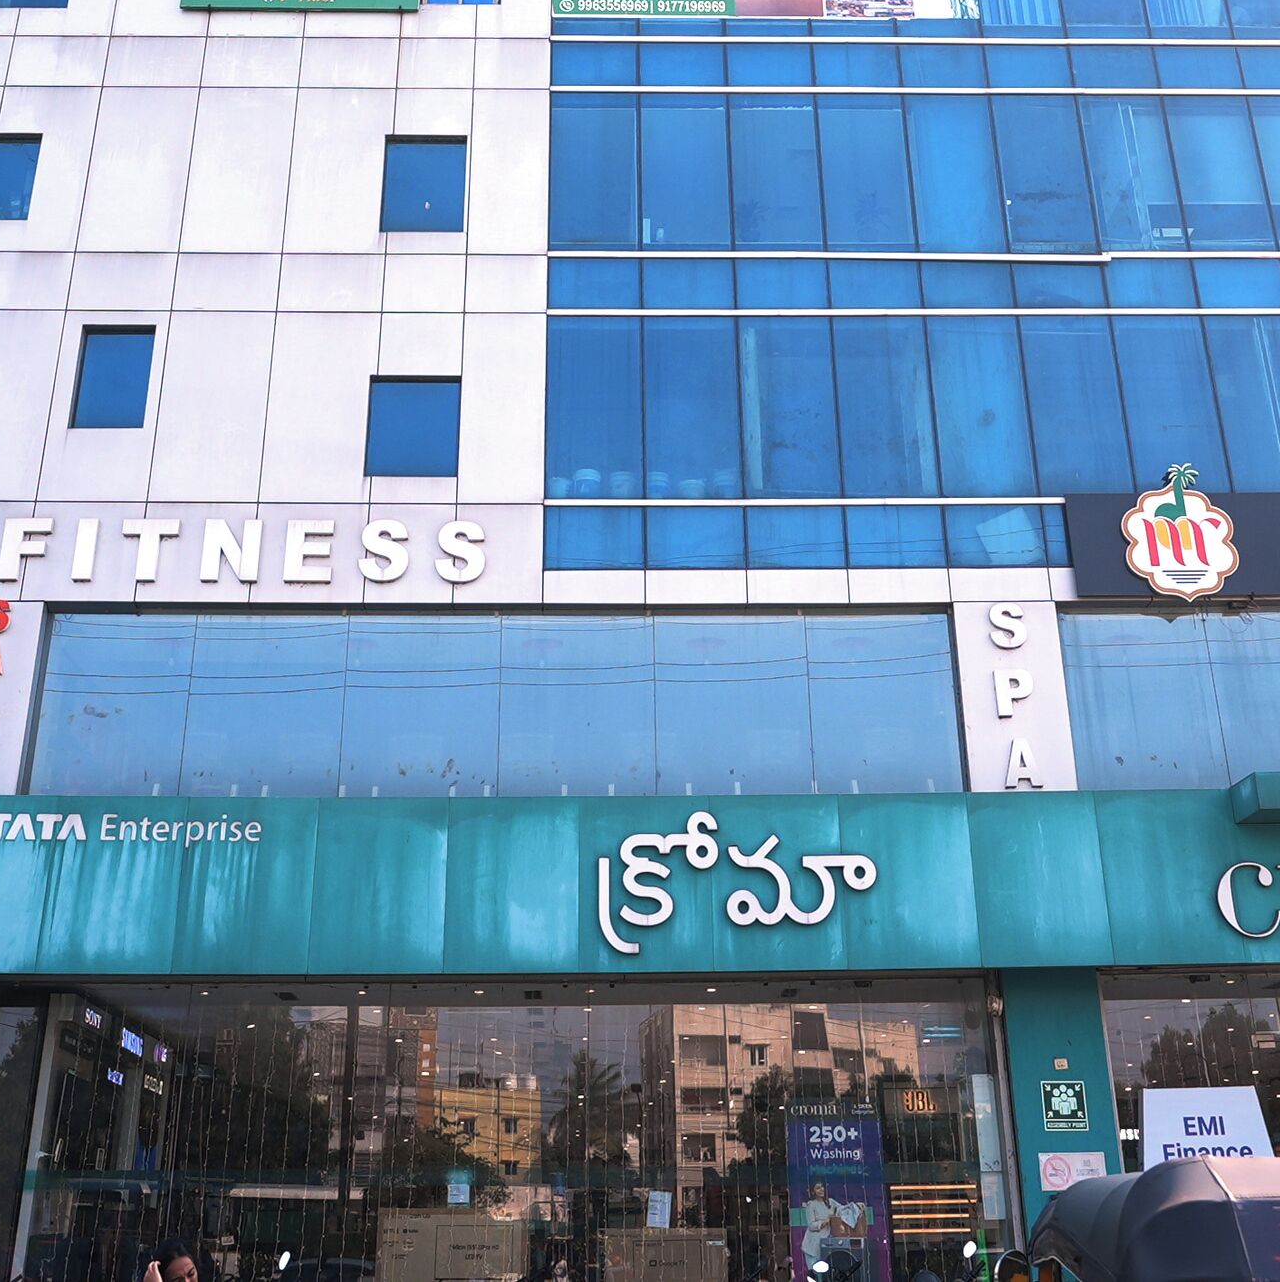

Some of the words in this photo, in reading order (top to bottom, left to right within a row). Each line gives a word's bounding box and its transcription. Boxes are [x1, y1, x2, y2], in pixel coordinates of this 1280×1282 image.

[988, 602, 1044, 789] SPA
[100, 814, 262, 848] Enterprise
[809, 1125, 859, 1144] 250+
[1183, 1116, 1226, 1137] EMI
[810, 1148, 861, 1160] Washing
